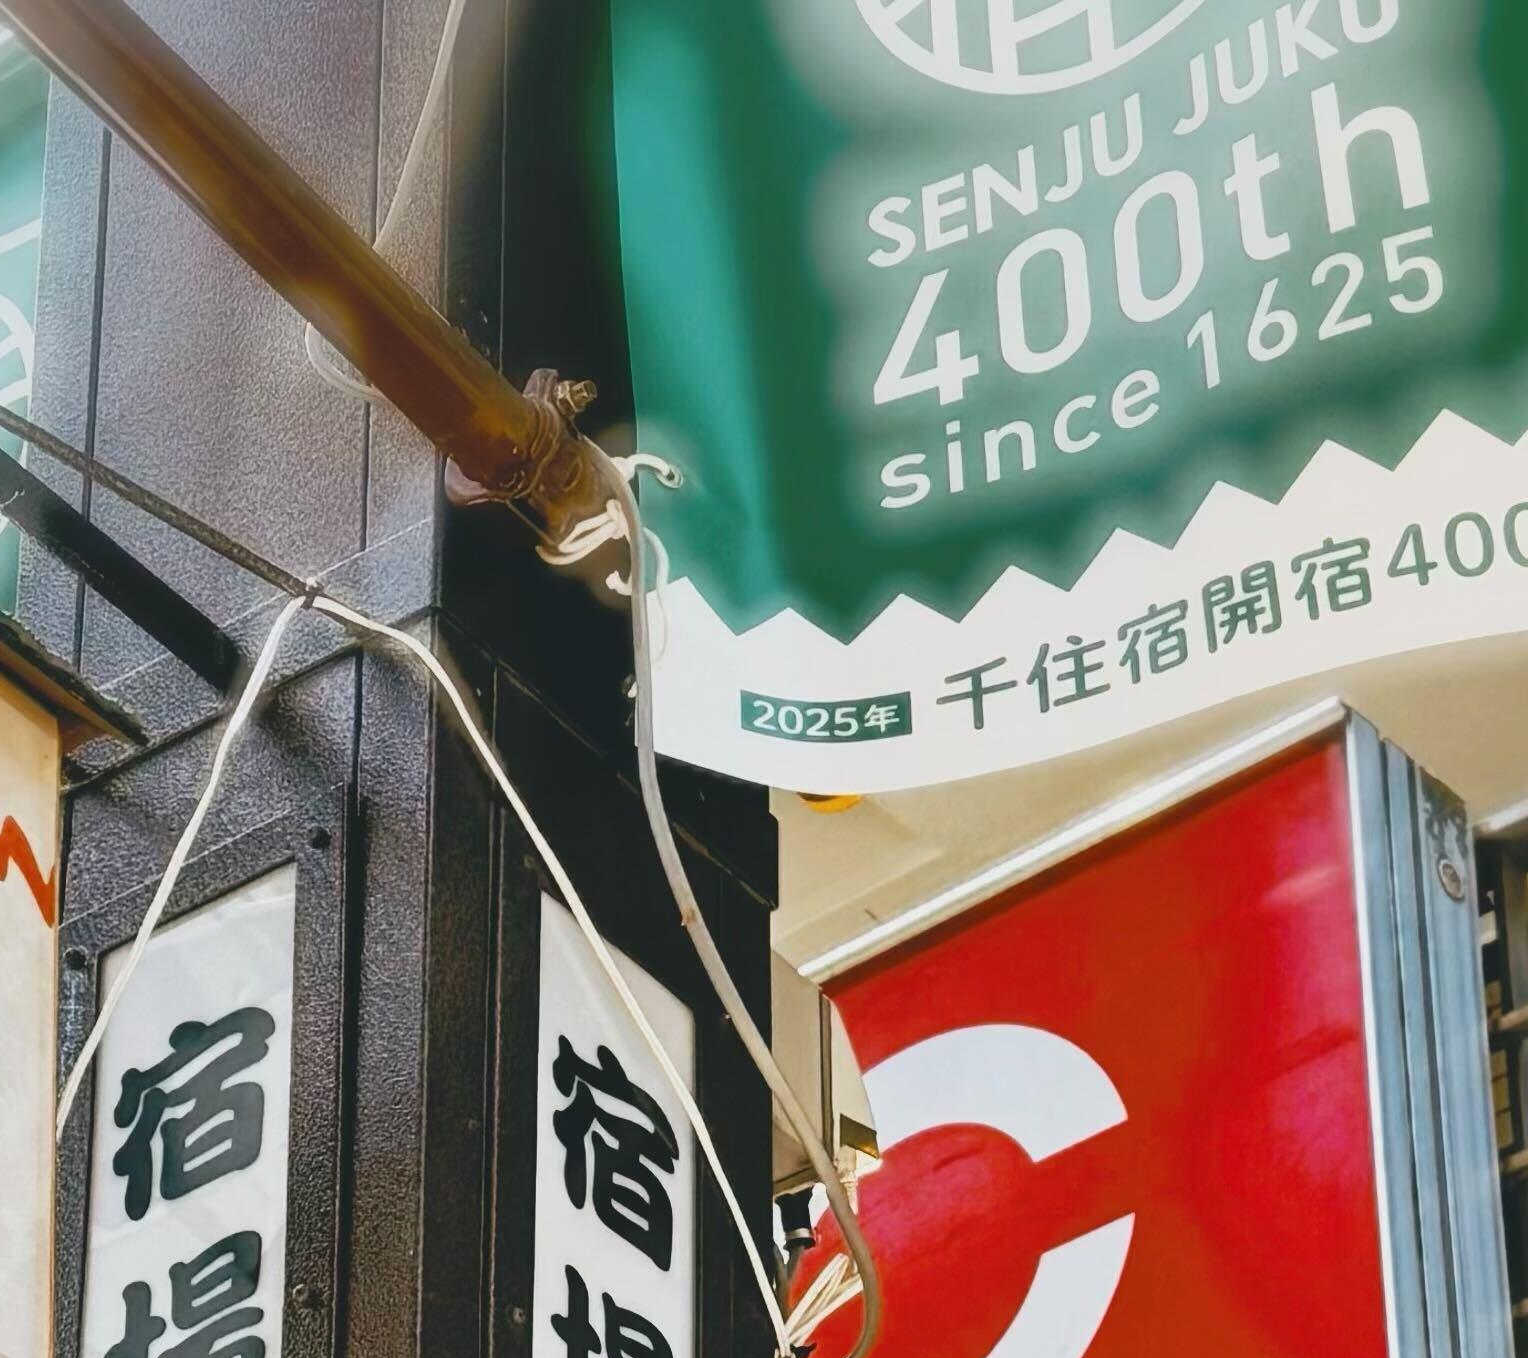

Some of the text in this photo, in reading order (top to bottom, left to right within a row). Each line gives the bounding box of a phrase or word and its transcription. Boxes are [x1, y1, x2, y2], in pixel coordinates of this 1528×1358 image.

[868, 93, 1143, 267] SENJU
[1174, 0, 1398, 135] JUKU
[874, 82, 1429, 405] 400th
[881, 227, 1444, 508] since 1625
[752, 700, 901, 737] 2025年
